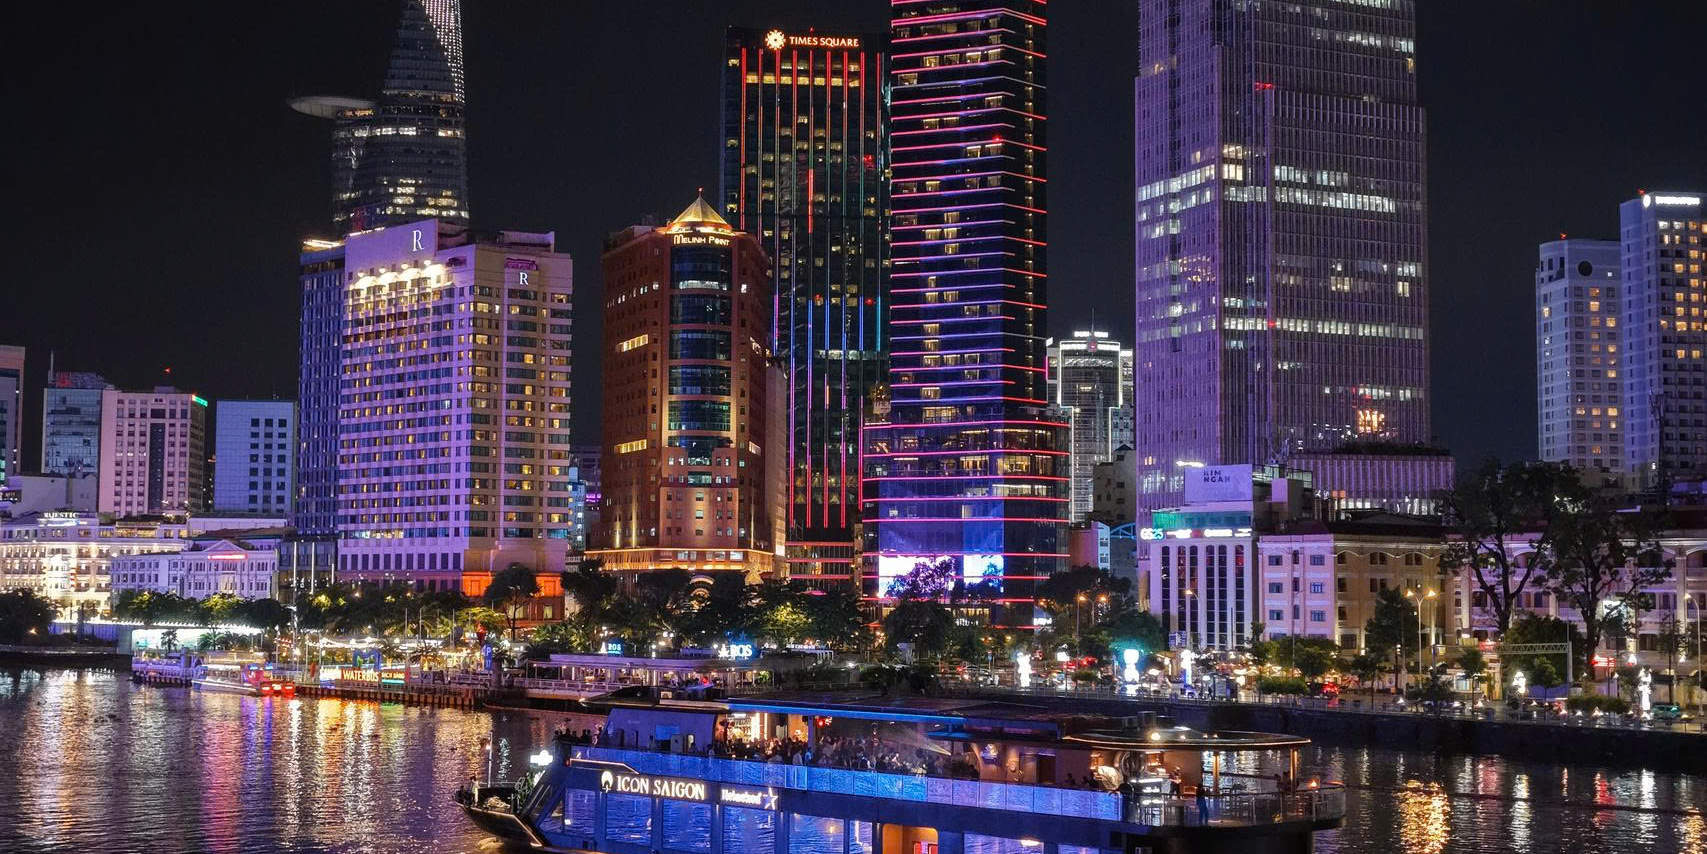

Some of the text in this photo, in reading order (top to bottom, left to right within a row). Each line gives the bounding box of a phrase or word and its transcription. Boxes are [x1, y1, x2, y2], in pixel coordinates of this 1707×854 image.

[789, 36, 860, 47] TIMES SQUARE
[412, 229, 424, 252] R
[519, 272, 529, 286] R
[342, 669, 379, 681] WATERBUS
[616, 775, 705, 800] ICON SAIGON
